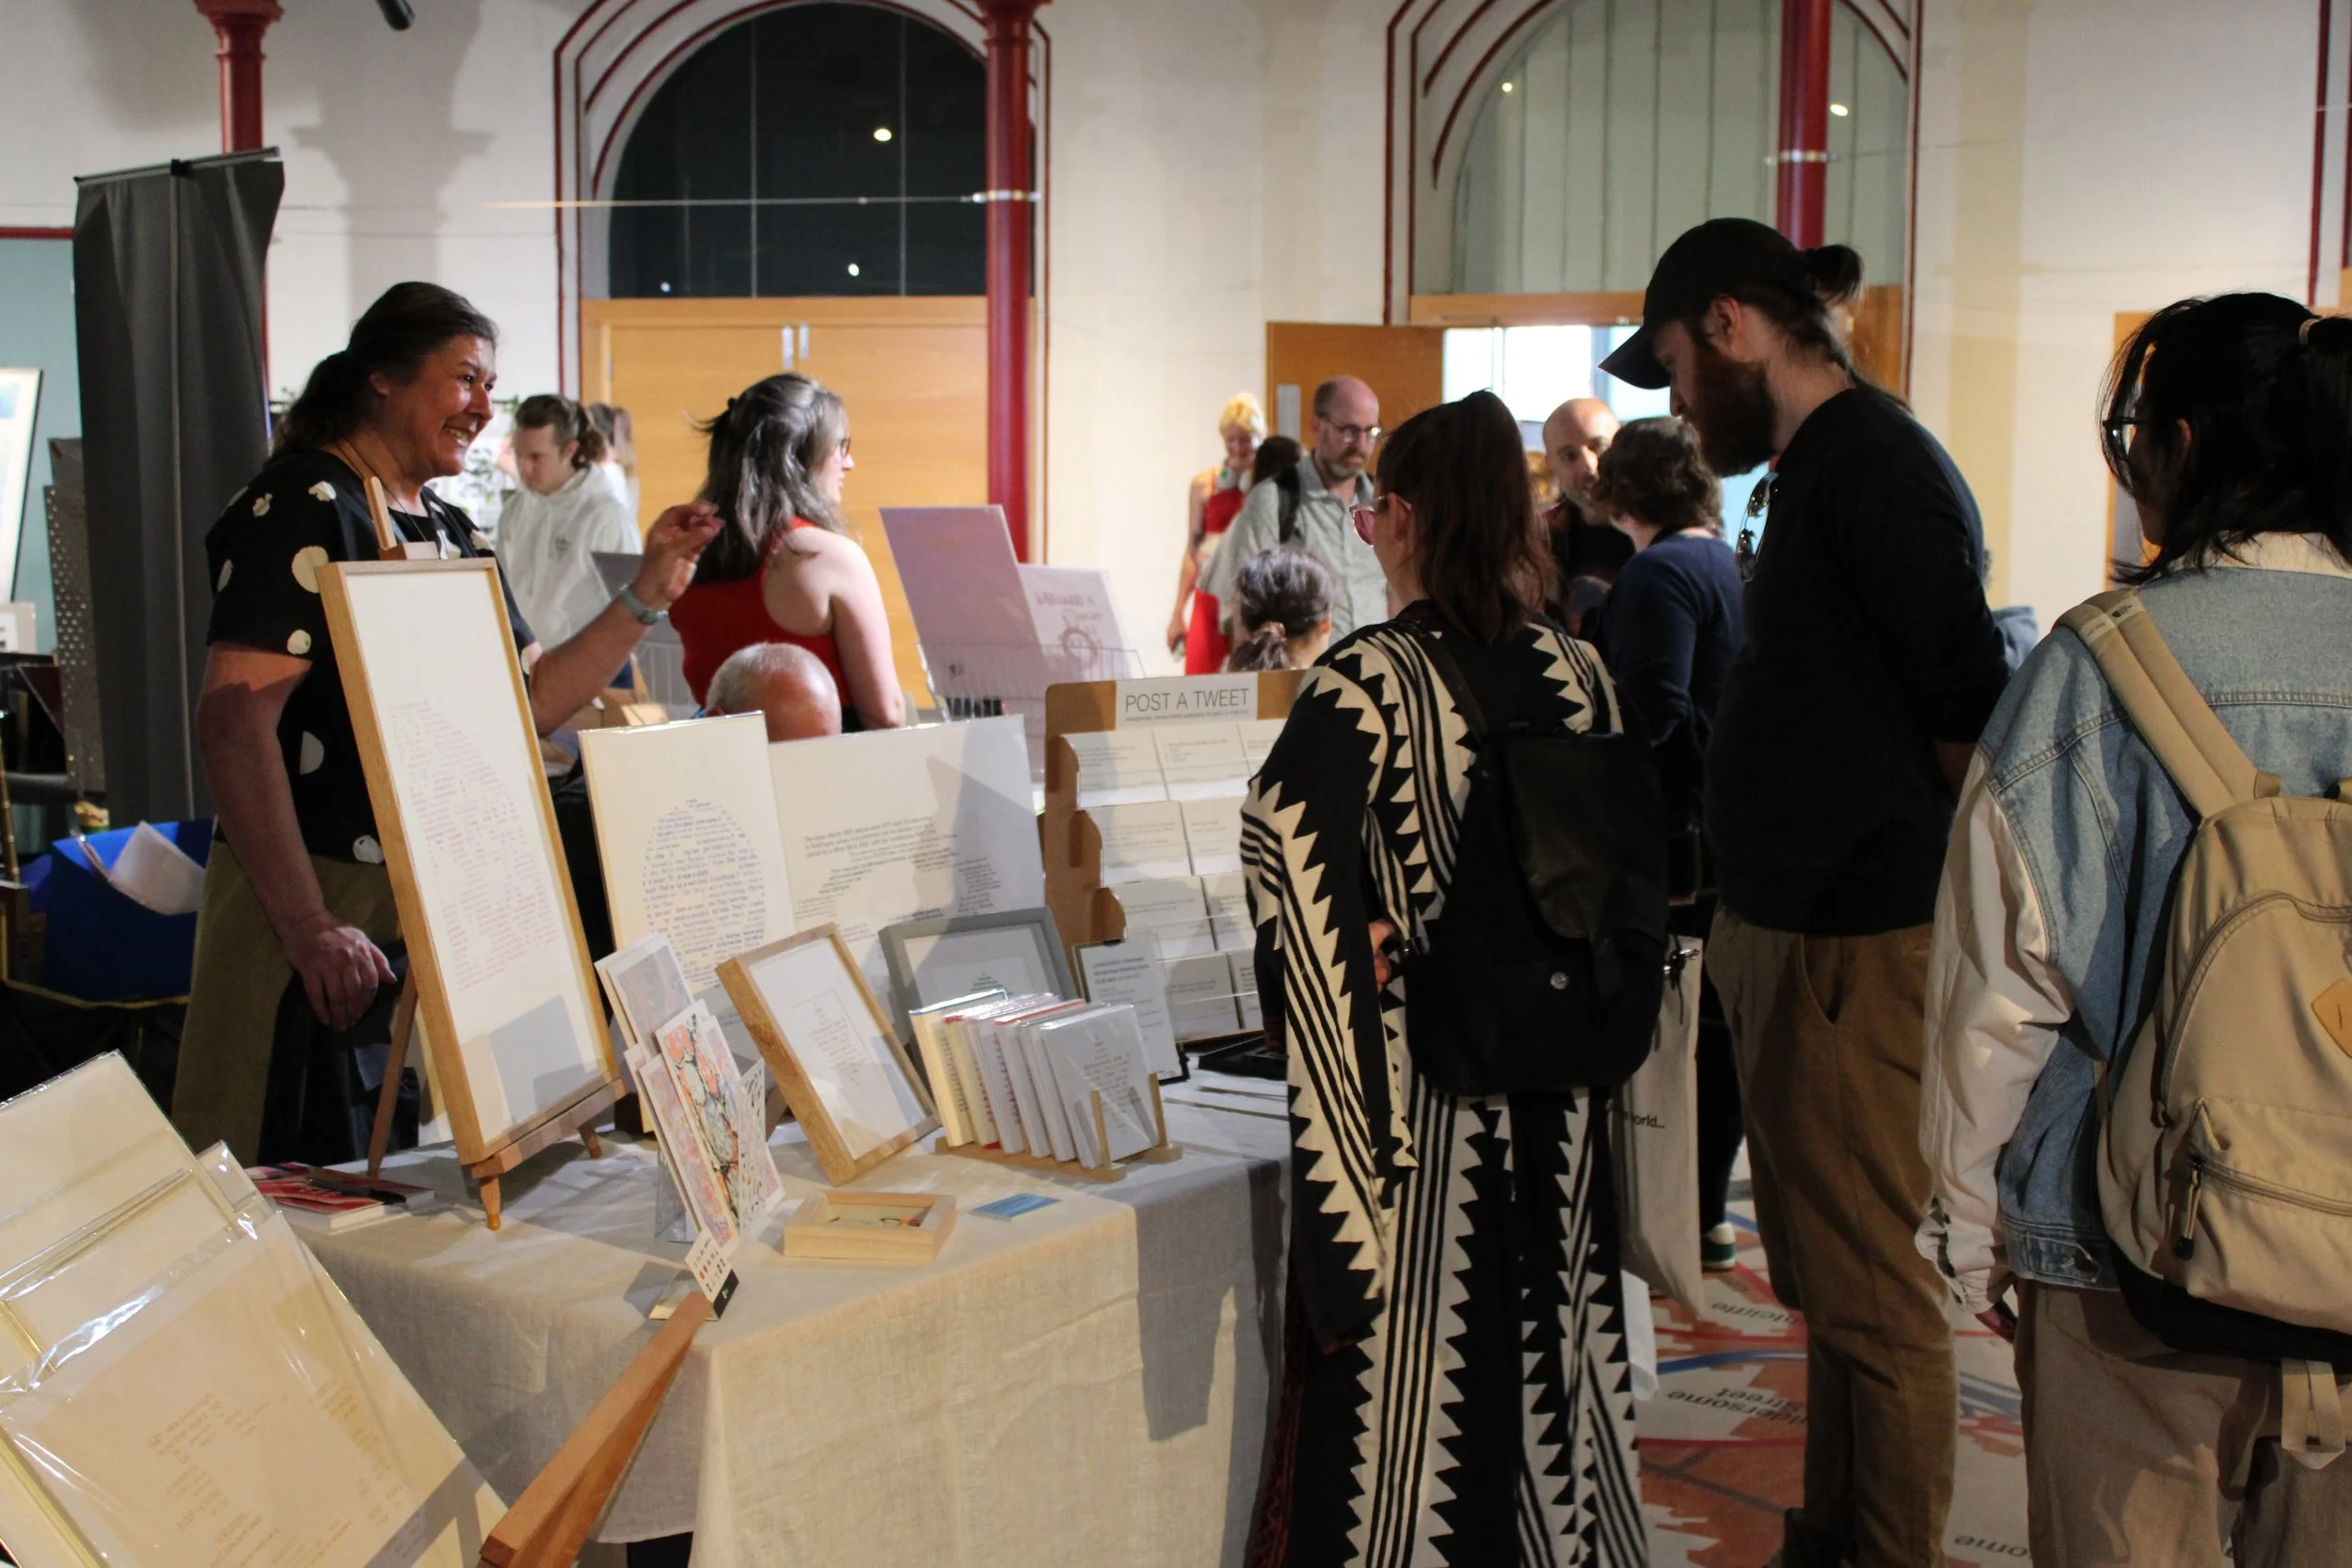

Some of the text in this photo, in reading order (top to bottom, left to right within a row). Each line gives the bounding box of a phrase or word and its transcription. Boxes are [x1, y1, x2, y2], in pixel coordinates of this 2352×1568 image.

[1125, 688, 1249, 713] POST A TWEET
